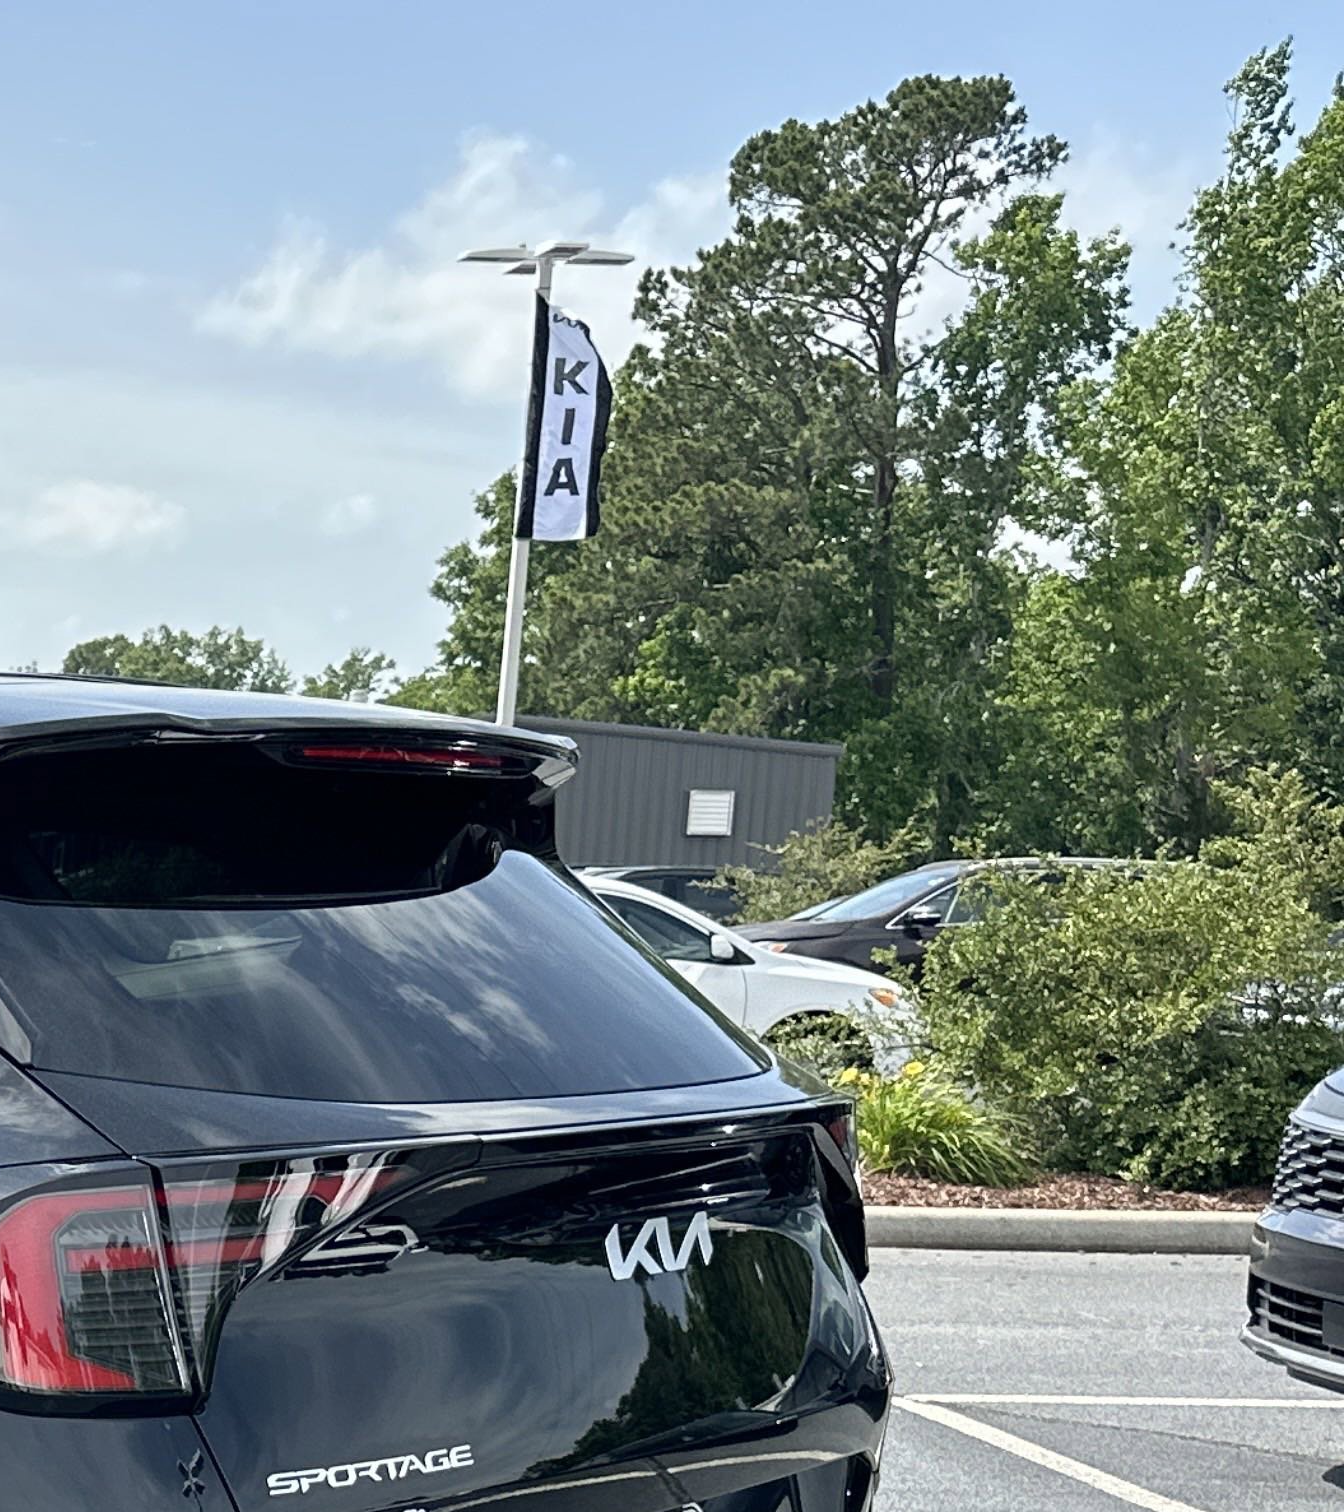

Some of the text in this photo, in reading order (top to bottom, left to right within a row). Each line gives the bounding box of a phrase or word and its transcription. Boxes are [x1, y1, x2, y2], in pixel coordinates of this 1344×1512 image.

[543, 357, 590, 496] KIA
[605, 1211, 714, 1281] KIA
[267, 1444, 475, 1496] SPORTAGE
